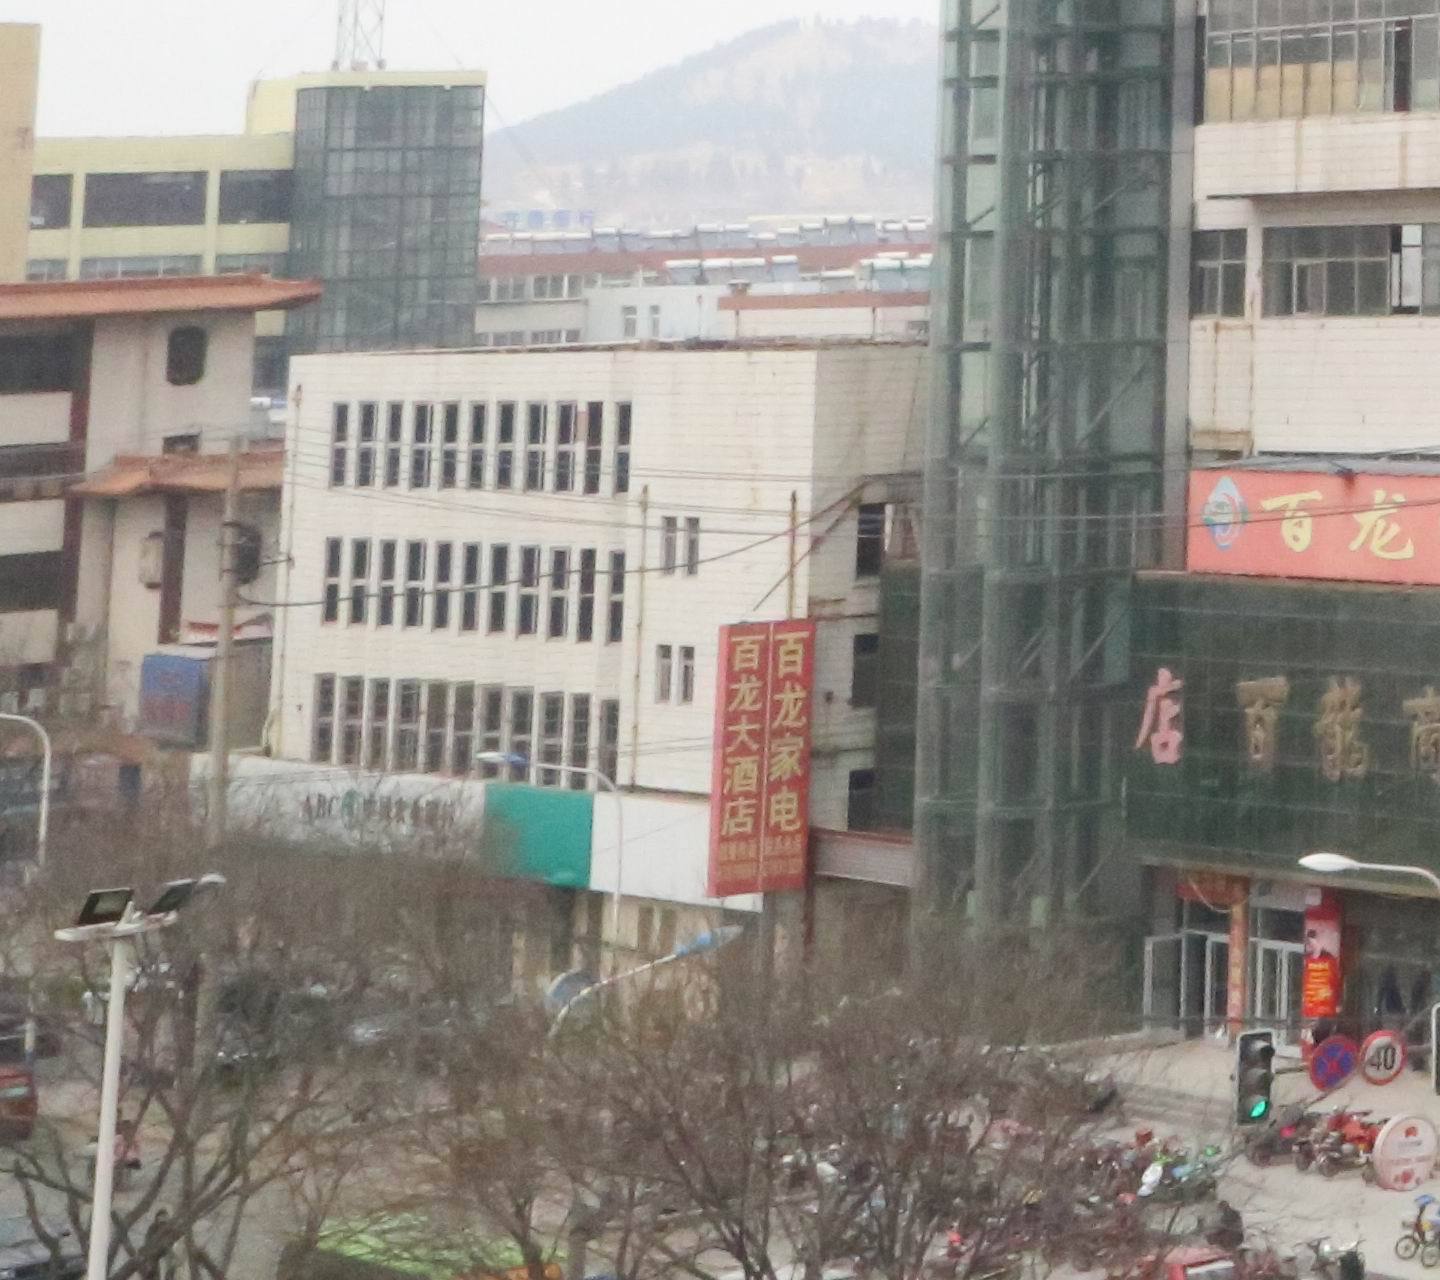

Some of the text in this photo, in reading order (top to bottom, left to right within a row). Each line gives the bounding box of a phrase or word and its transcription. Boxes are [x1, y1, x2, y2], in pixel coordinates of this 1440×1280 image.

[720, 634, 767, 836] 百龙大酒店
[768, 630, 809, 833] 百龙家电
[1136, 666, 1184, 765] 店
[1370, 1045, 1398, 1072] 40
